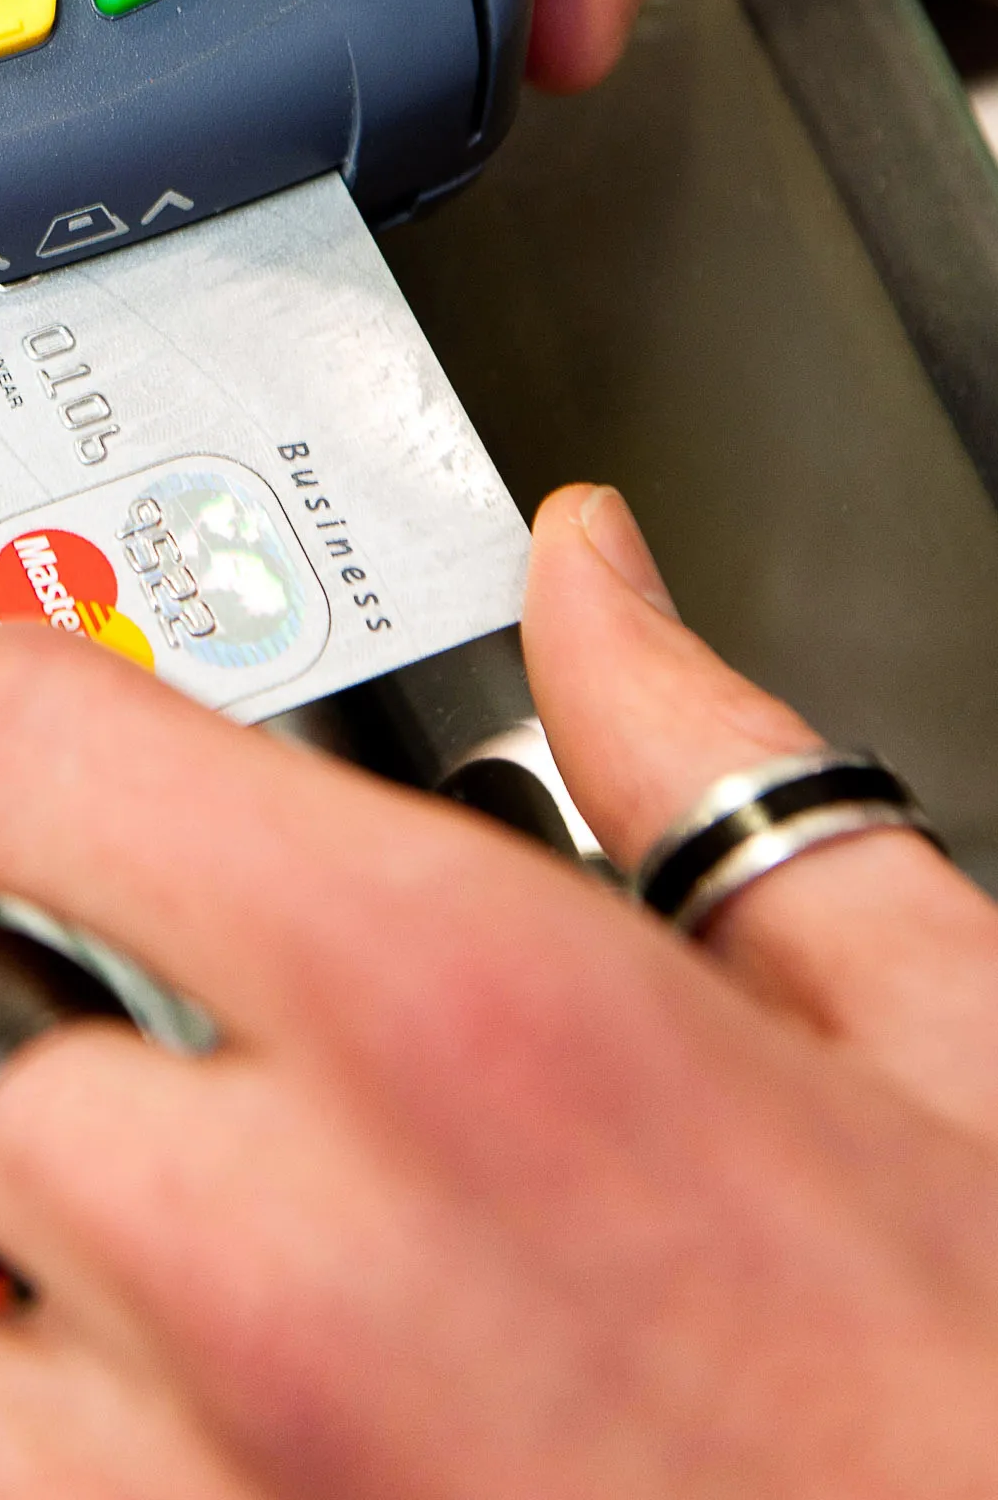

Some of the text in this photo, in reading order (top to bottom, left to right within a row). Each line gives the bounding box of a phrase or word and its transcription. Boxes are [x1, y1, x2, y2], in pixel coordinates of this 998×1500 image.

[22, 323, 217, 649] 0106 9522
[277, 441, 392, 631] Business
[13, 533, 86, 636] Maste
